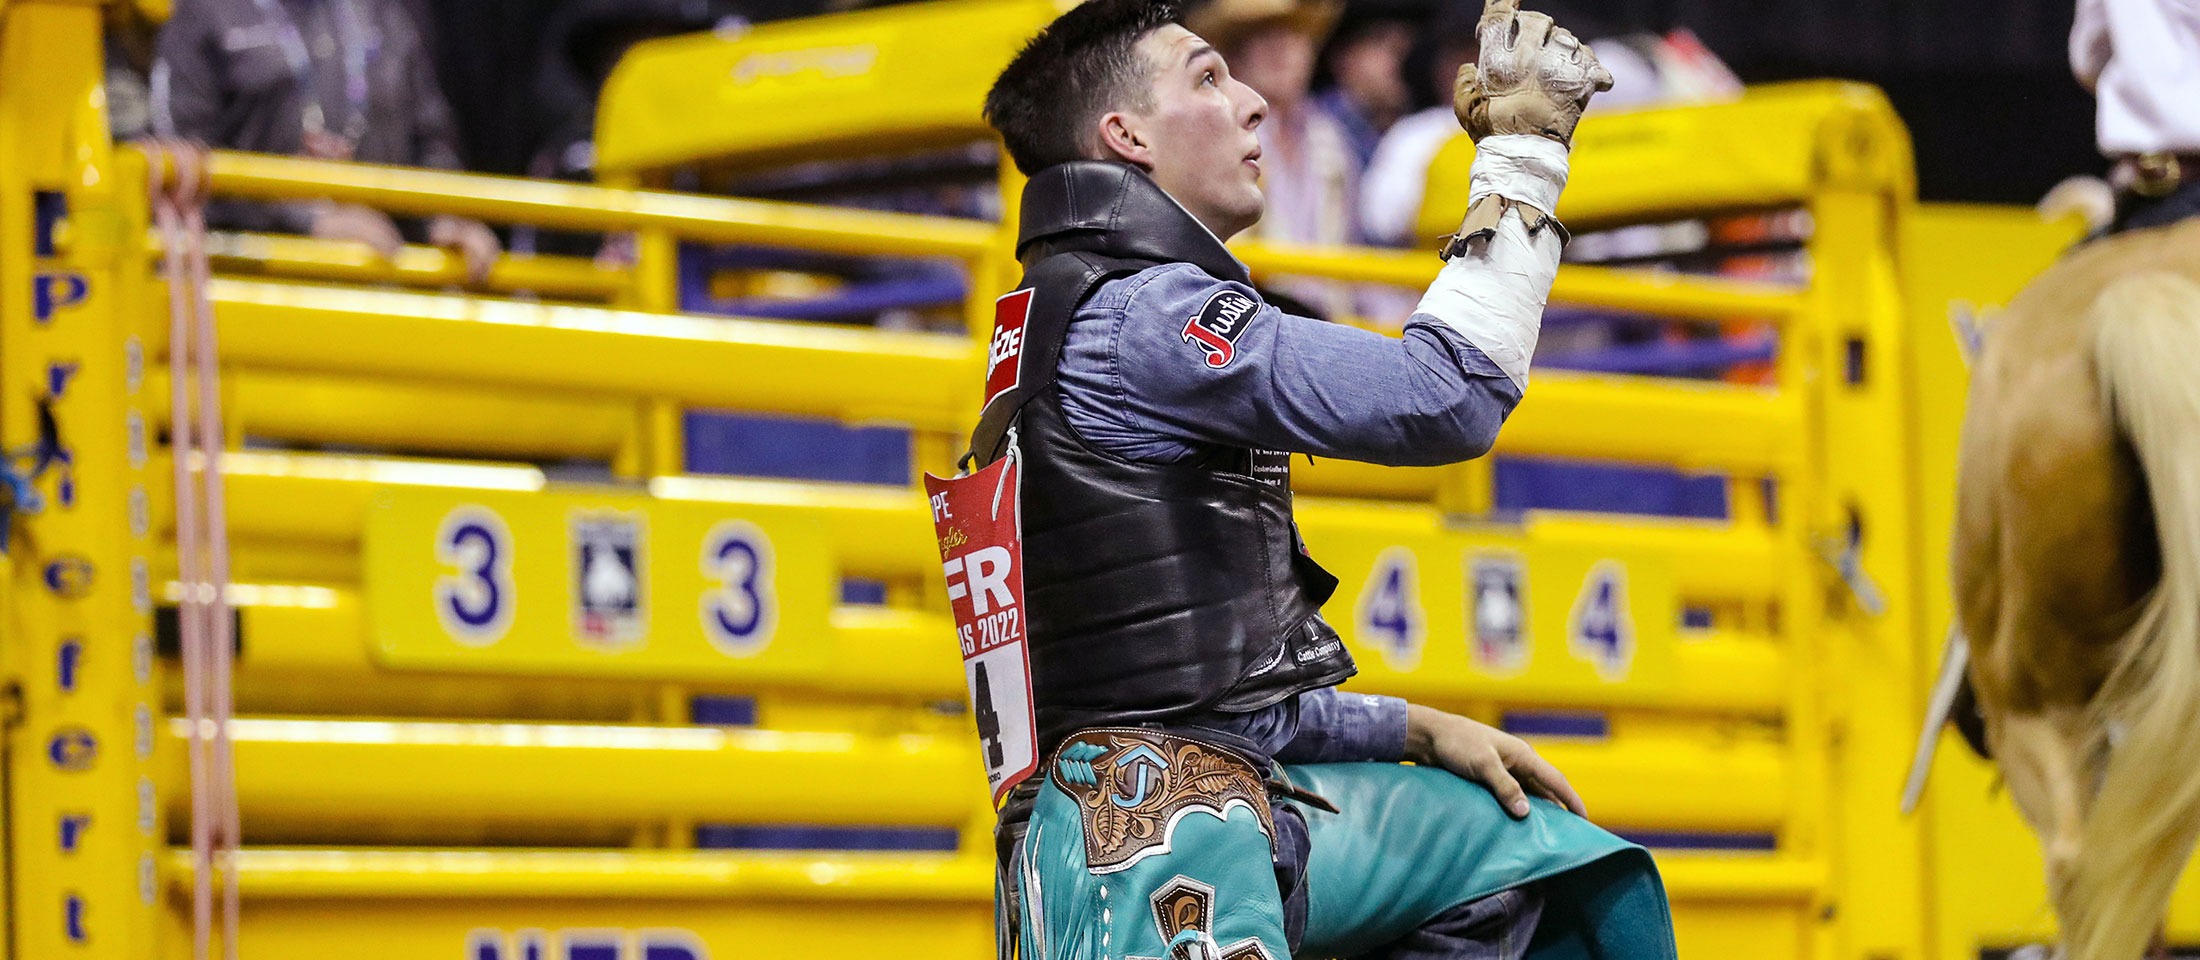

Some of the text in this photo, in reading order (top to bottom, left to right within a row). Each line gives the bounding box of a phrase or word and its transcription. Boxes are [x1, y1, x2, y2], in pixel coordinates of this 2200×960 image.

[1182, 294, 1258, 367] Justin
[930, 491, 953, 523] PE
[447, 517, 769, 646] 3 3
[1364, 558, 1625, 669] 4 4
[978, 607, 1021, 649] 2022
[1297, 640, 1341, 663] Cattle Company
[976, 661, 1004, 769] 4
